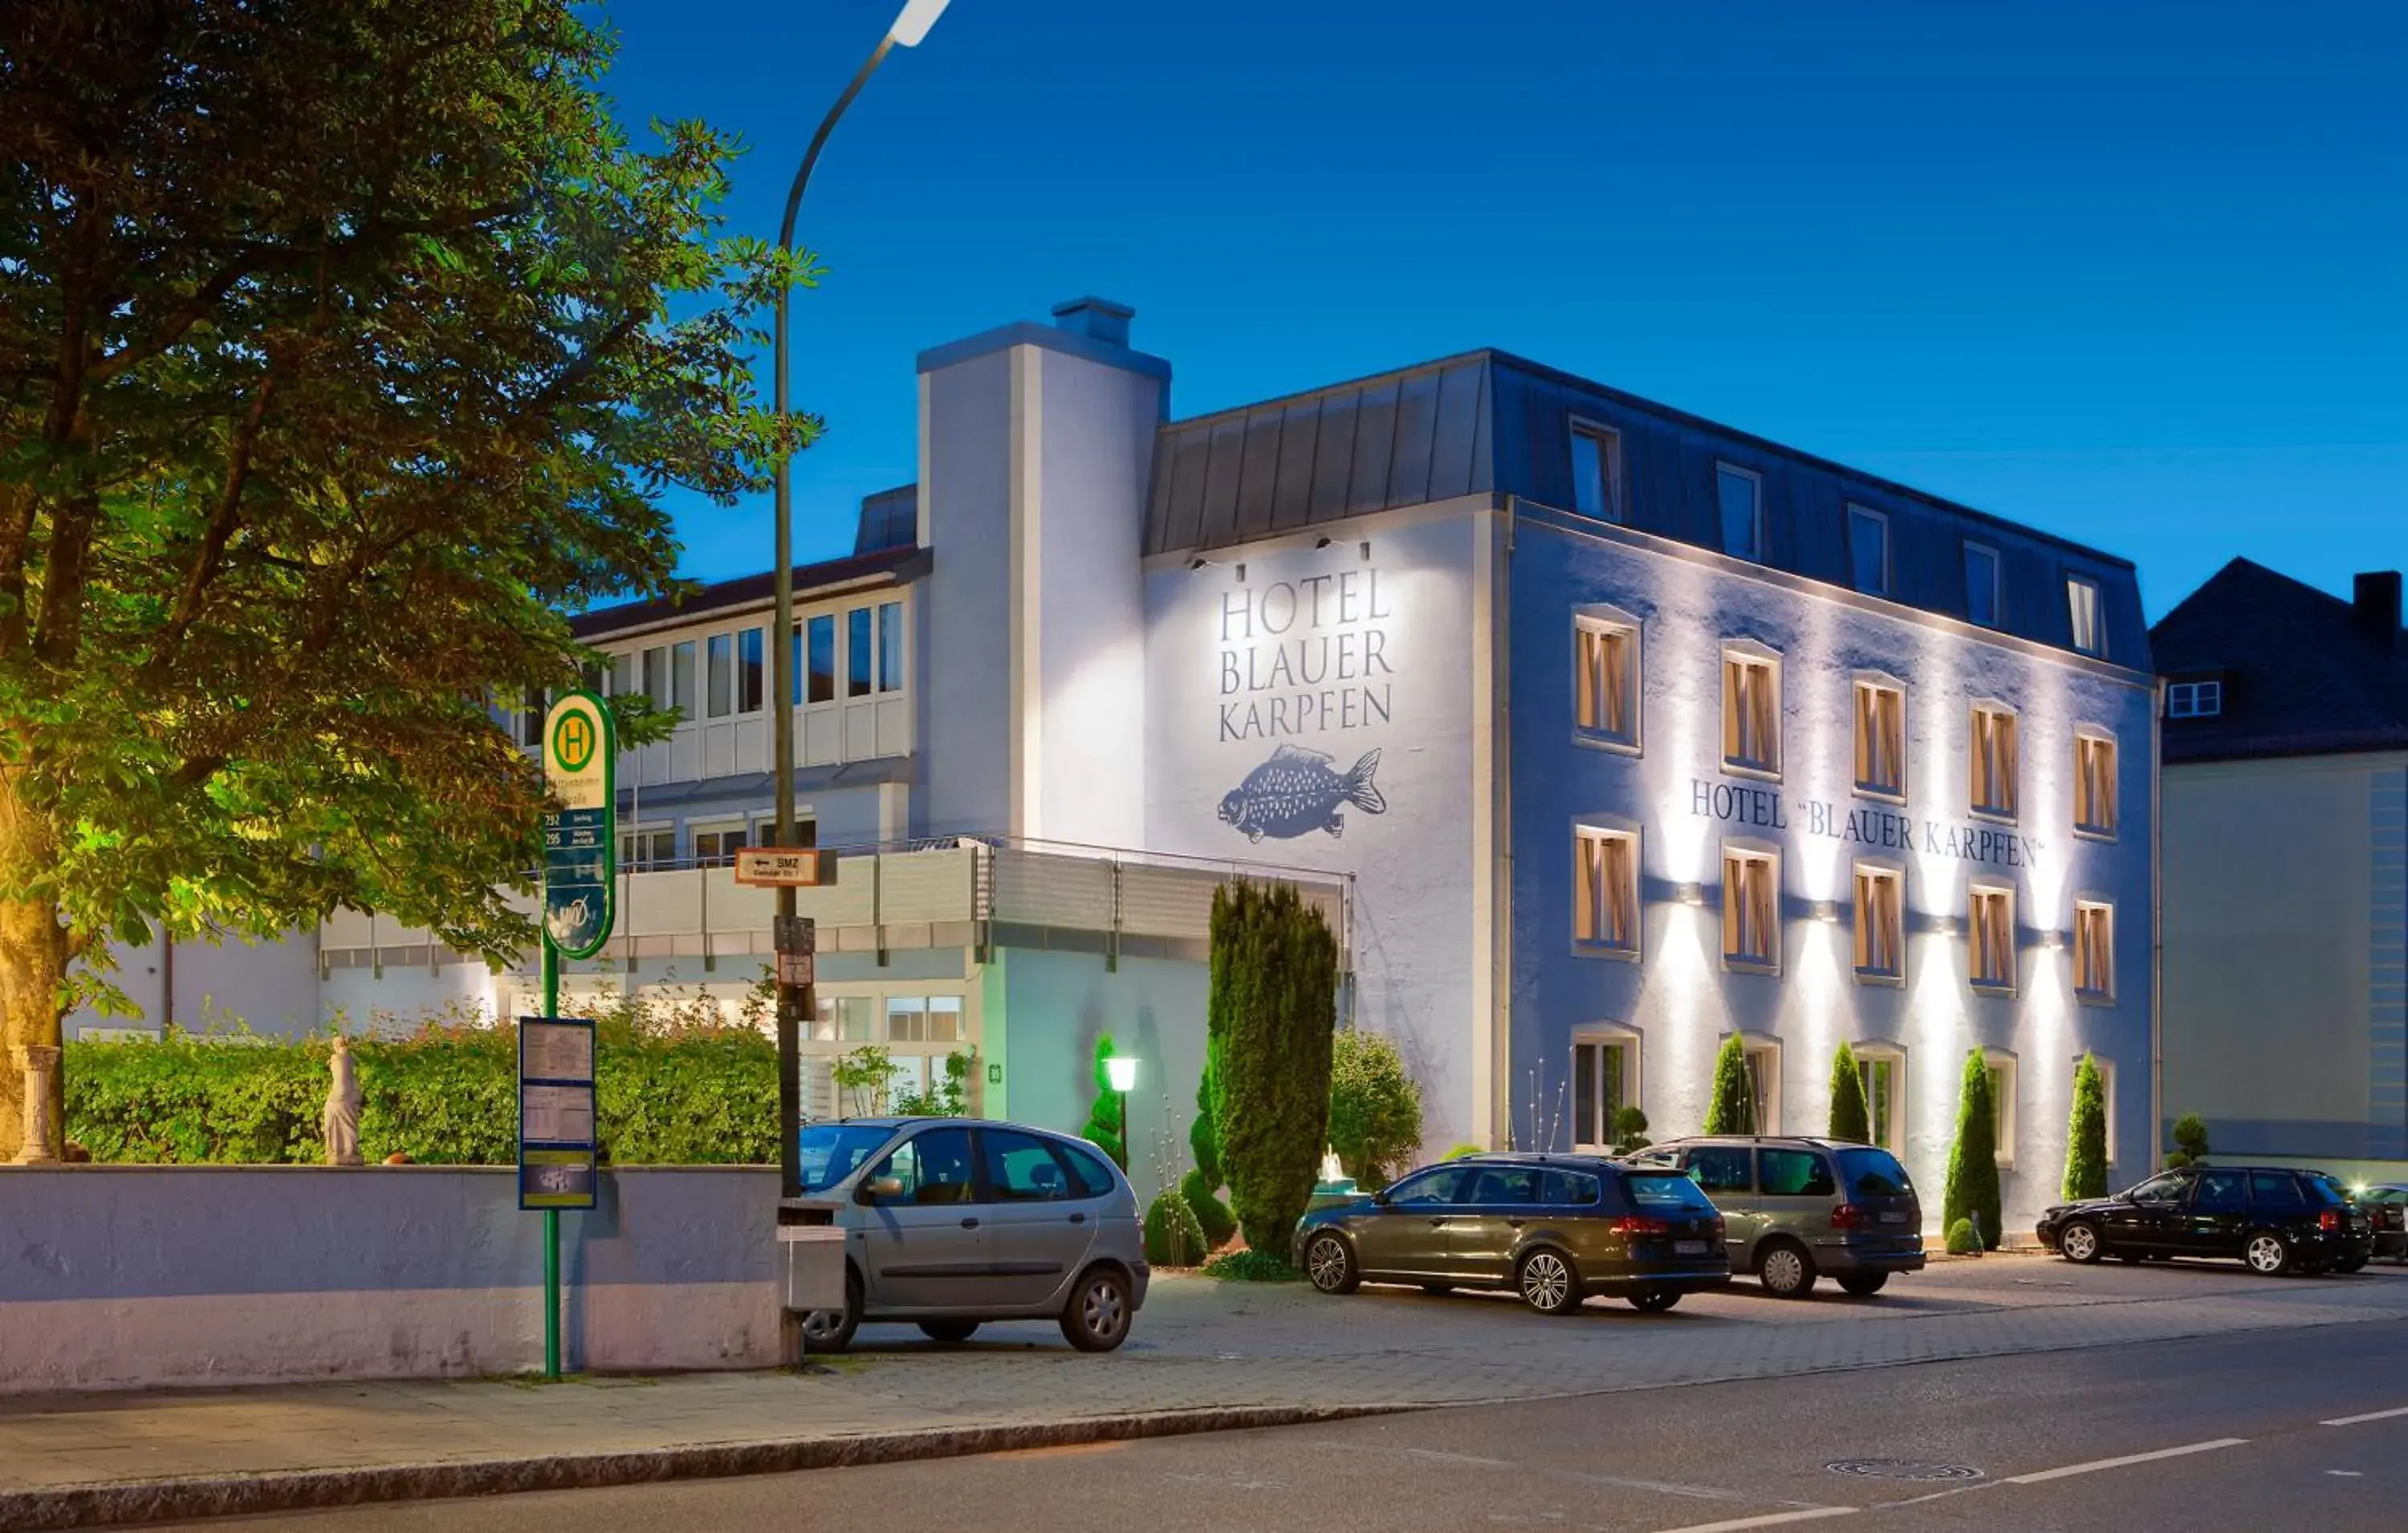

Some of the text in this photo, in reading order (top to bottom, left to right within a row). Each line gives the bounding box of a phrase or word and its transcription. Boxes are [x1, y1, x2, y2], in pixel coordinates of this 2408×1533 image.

[1220, 567, 1391, 642] HOTEL
[1219, 629, 1396, 695] BLAUER
[565, 722, 583, 758] H
[1218, 683, 1391, 742] KARPFEN
[1690, 779, 1788, 829] HOTEL
